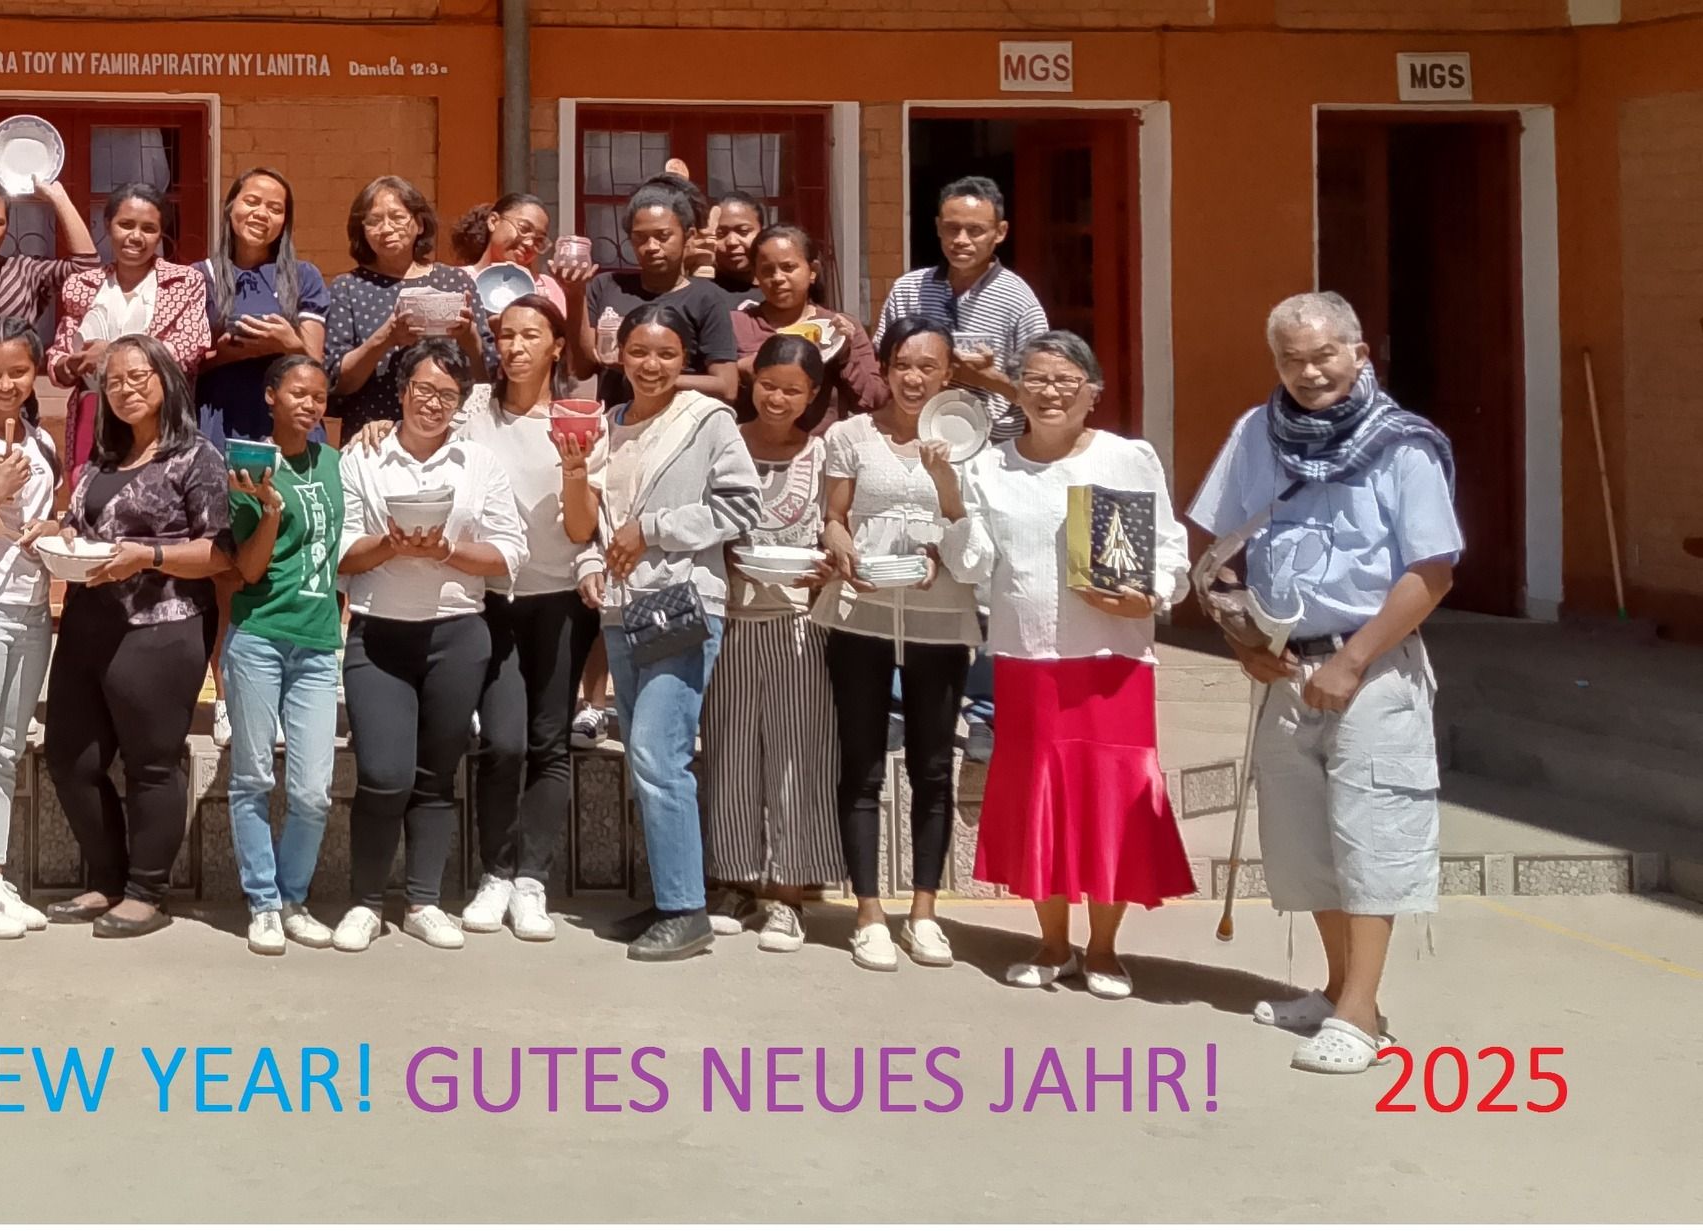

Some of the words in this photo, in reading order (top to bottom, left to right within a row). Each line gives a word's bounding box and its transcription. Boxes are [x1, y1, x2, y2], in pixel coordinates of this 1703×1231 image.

[22, 51, 57, 74] TOY
[61, 52, 86, 74] NY
[90, 52, 225, 76] FAMIRAPIRATRY
[228, 53, 253, 76] NY
[256, 53, 331, 77] LANITRA
[348, 56, 405, 76] Daniela
[1004, 54, 1070, 82] MGS
[1409, 63, 1465, 89] MGS
